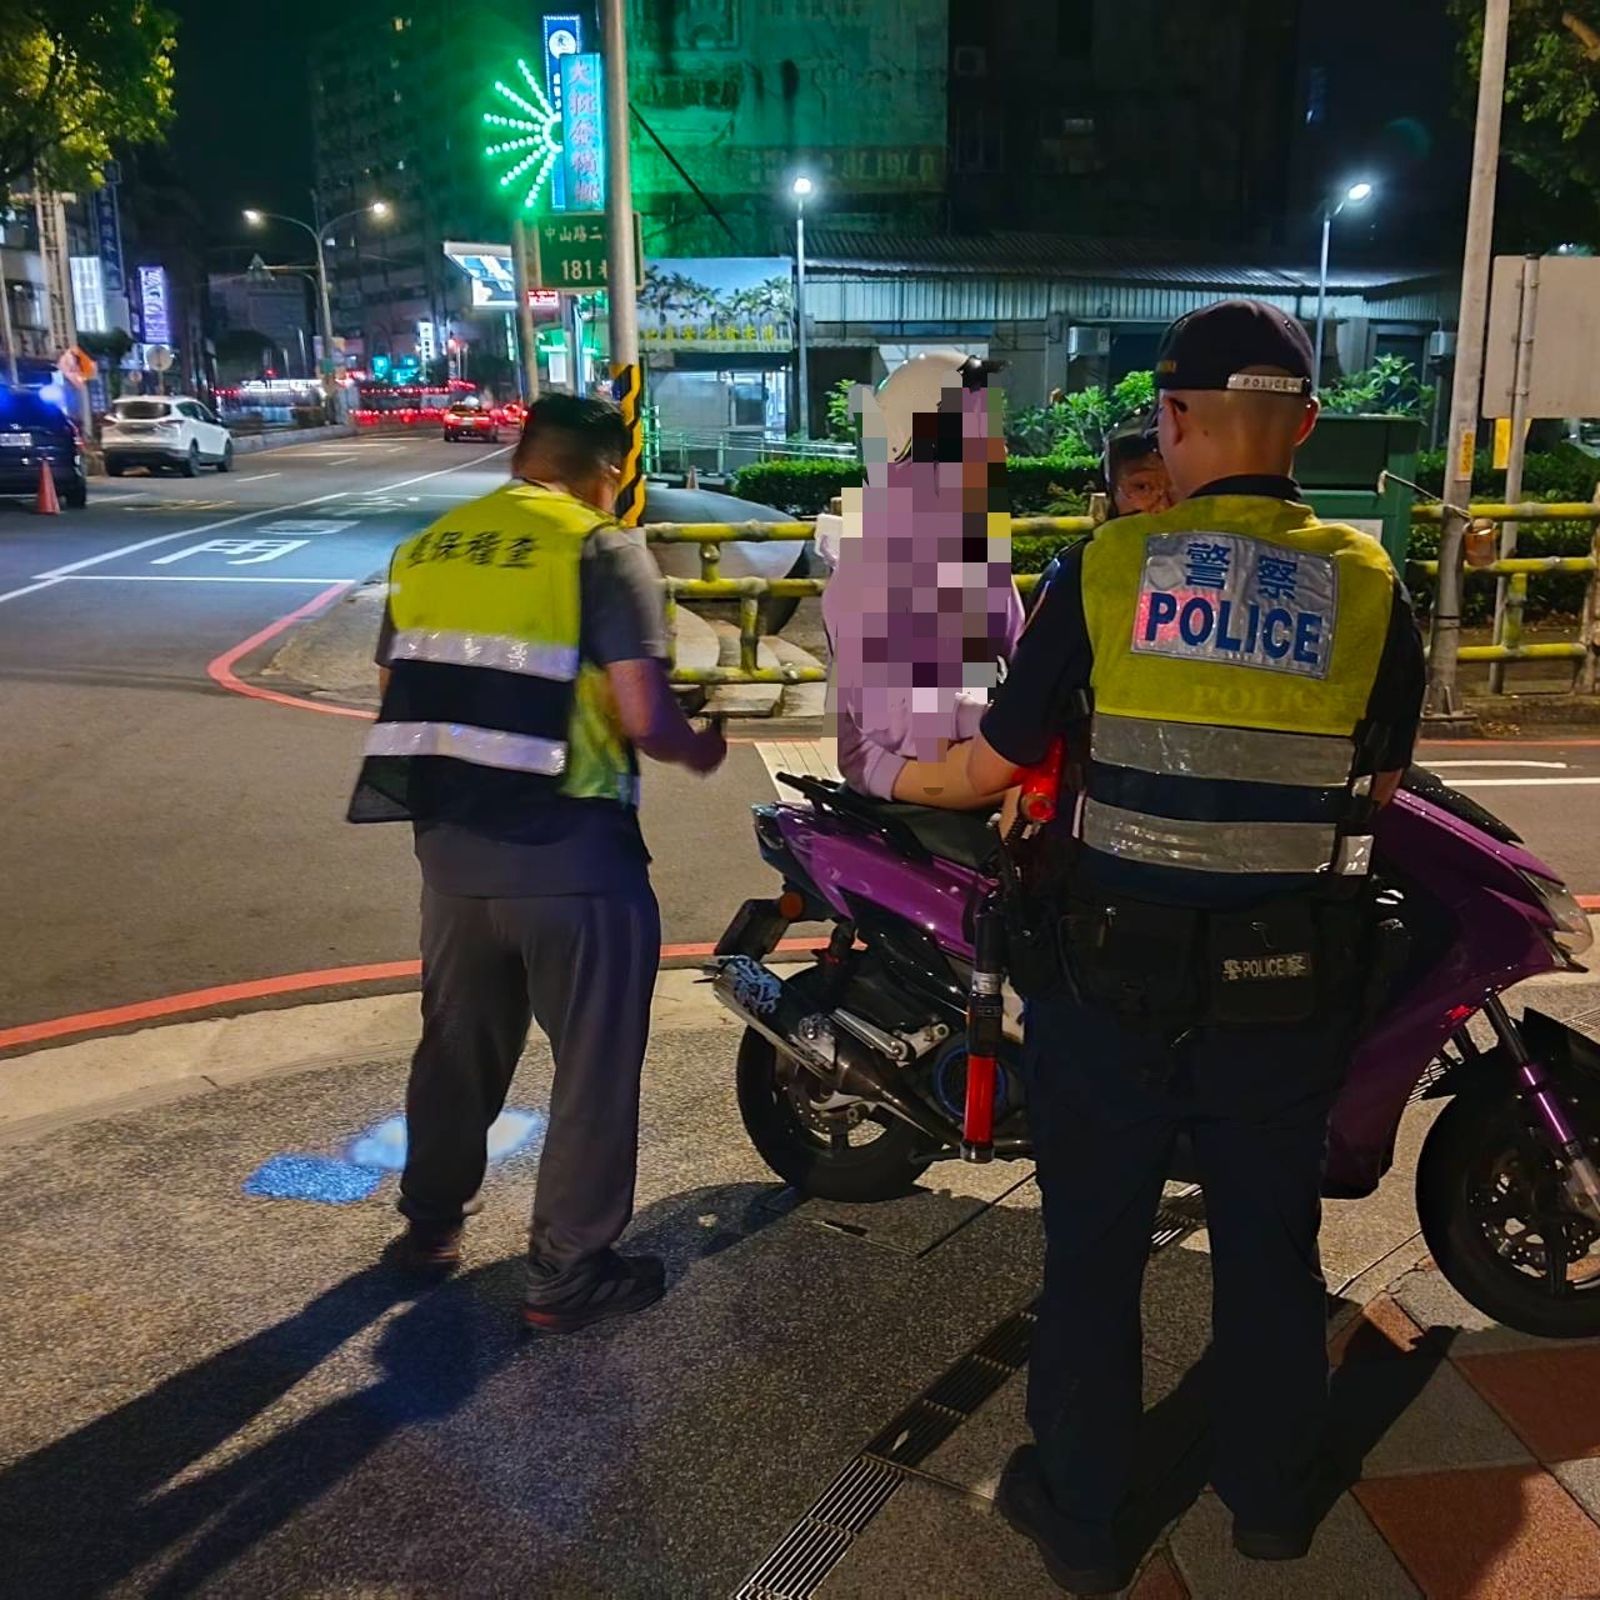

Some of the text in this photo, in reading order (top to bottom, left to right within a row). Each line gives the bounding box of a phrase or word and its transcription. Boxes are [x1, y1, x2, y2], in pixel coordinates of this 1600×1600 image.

[544, 223, 607, 244] 中山路二
[1242, 377, 1288, 388] POLICE
[1186, 543, 1298, 600] 警察
[1145, 592, 1322, 664] POLICE
